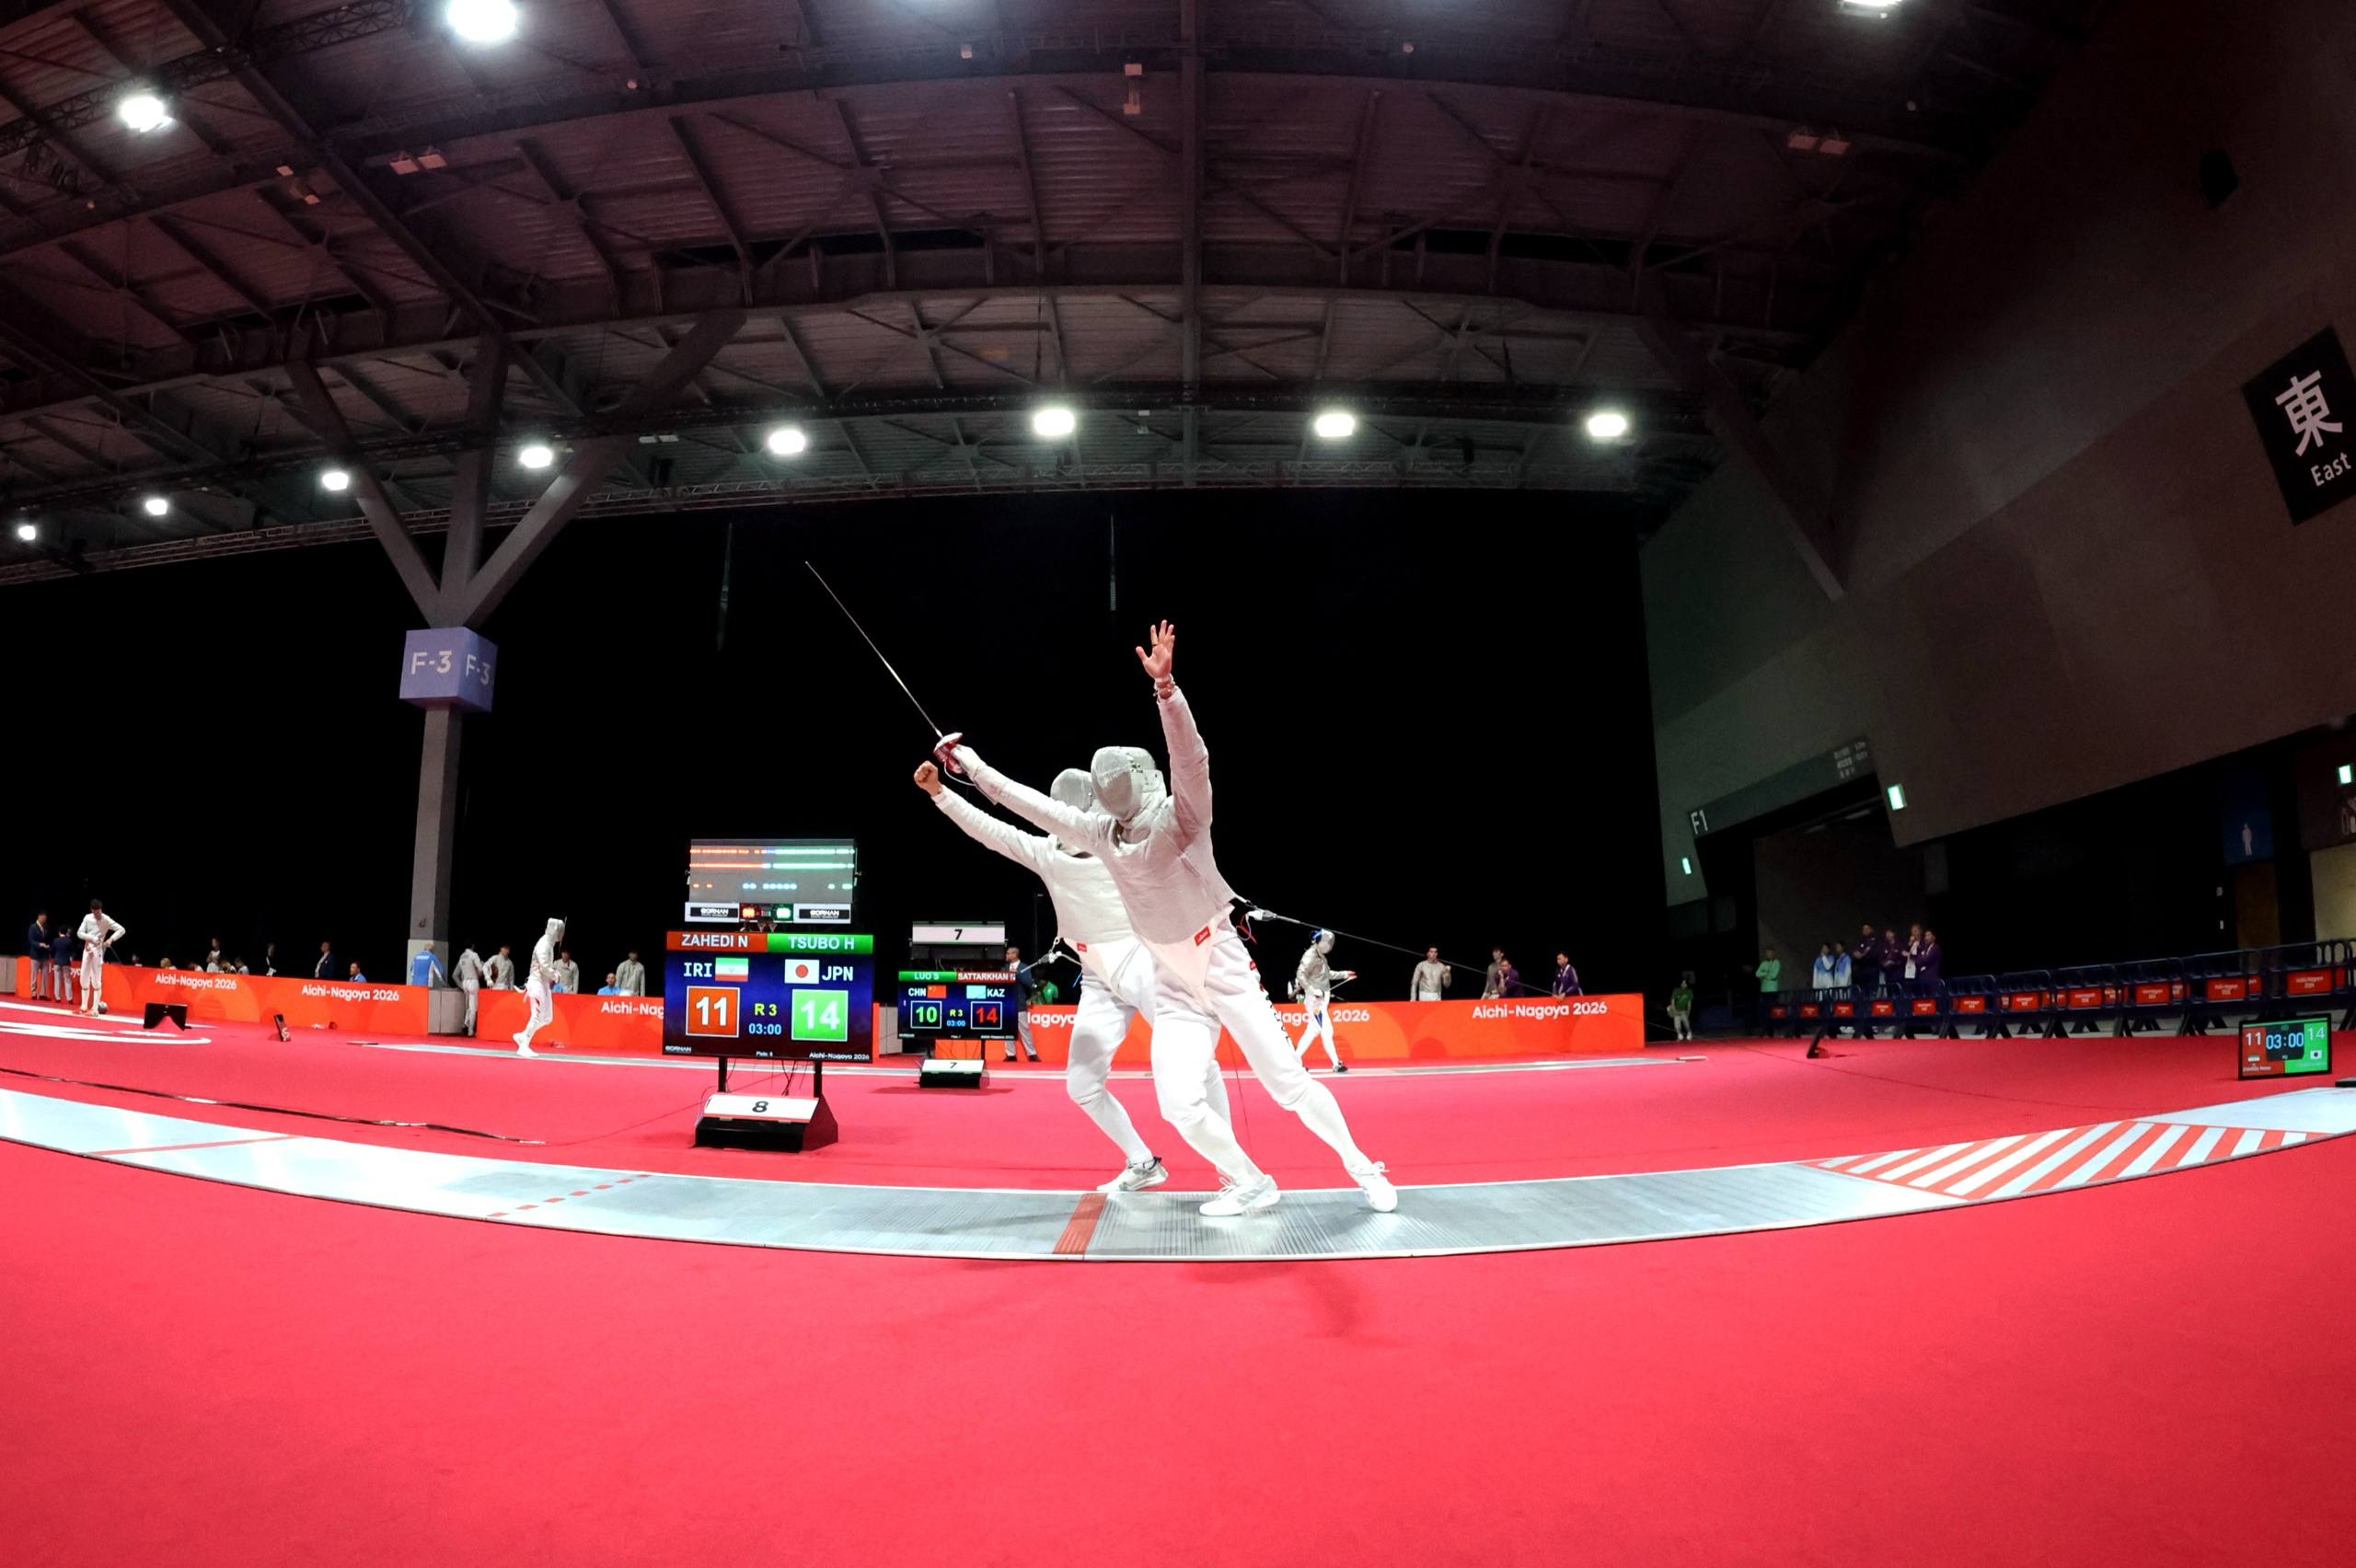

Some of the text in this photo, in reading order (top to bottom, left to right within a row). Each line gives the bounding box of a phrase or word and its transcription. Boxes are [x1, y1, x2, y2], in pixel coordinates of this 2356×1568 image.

[2275, 370, 2343, 457] 東
[2310, 452, 2352, 487] East
[410, 650, 453, 675] F-3
[466, 653, 491, 686] F-3
[1690, 809, 1709, 835] F1
[681, 934, 748, 948] ZAHEDI N
[954, 929, 963, 940] 7
[789, 937, 854, 950] TSUBO H
[683, 963, 712, 977] IRI
[822, 966, 853, 981] JPN
[958, 972, 1008, 981] SATTARKHAN
[156, 973, 237, 990] Aichi-Nagoya 2026
[302, 984, 399, 1001] Aichi-Nagoya 2026
[908, 987, 927, 997] CHN
[987, 988, 1005, 997] KAZ
[601, 1001, 664, 1020] Aichi-Nag
[696, 997, 728, 1026] 11
[754, 1003, 778, 1016] R 3
[801, 999, 840, 1031] 14
[916, 1007, 937, 1022] 10
[976, 1008, 998, 1023] 14
[1333, 1009, 1370, 1022] 2026
[1472, 1001, 1608, 1020] Aichi-Nagoya 2026
[748, 1023, 782, 1035] 03:00
[2308, 1027, 2325, 1041] 14
[2246, 1032, 2261, 1046] 11
[2266, 1032, 2304, 1049] 03:00
[752, 1101, 769, 1113] 8
